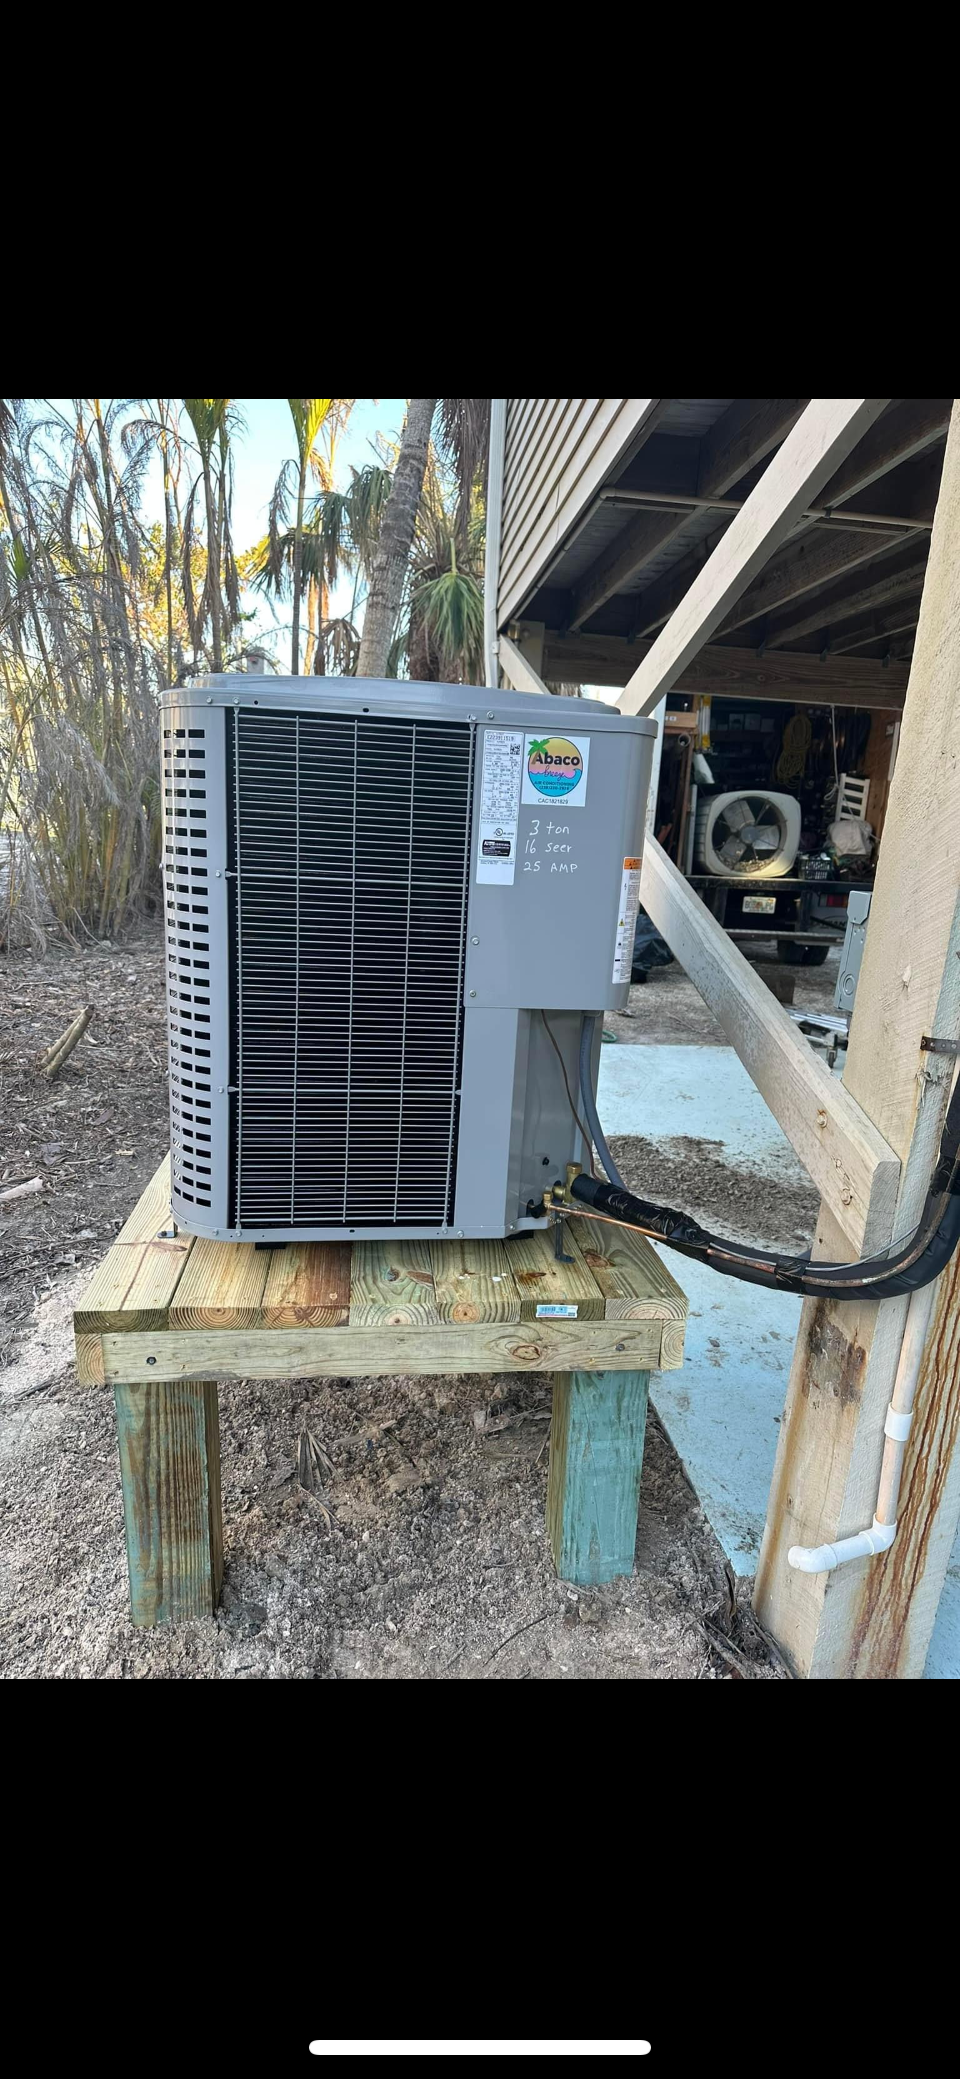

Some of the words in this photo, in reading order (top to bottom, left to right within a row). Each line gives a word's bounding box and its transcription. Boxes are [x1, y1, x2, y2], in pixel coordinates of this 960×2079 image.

[531, 752, 580, 766] Abaco
[529, 819, 540, 836] 3
[546, 821, 570, 835] ton
[525, 838, 536, 854] 16
[523, 860, 541, 872] 25
[550, 862, 578, 874] AMP
